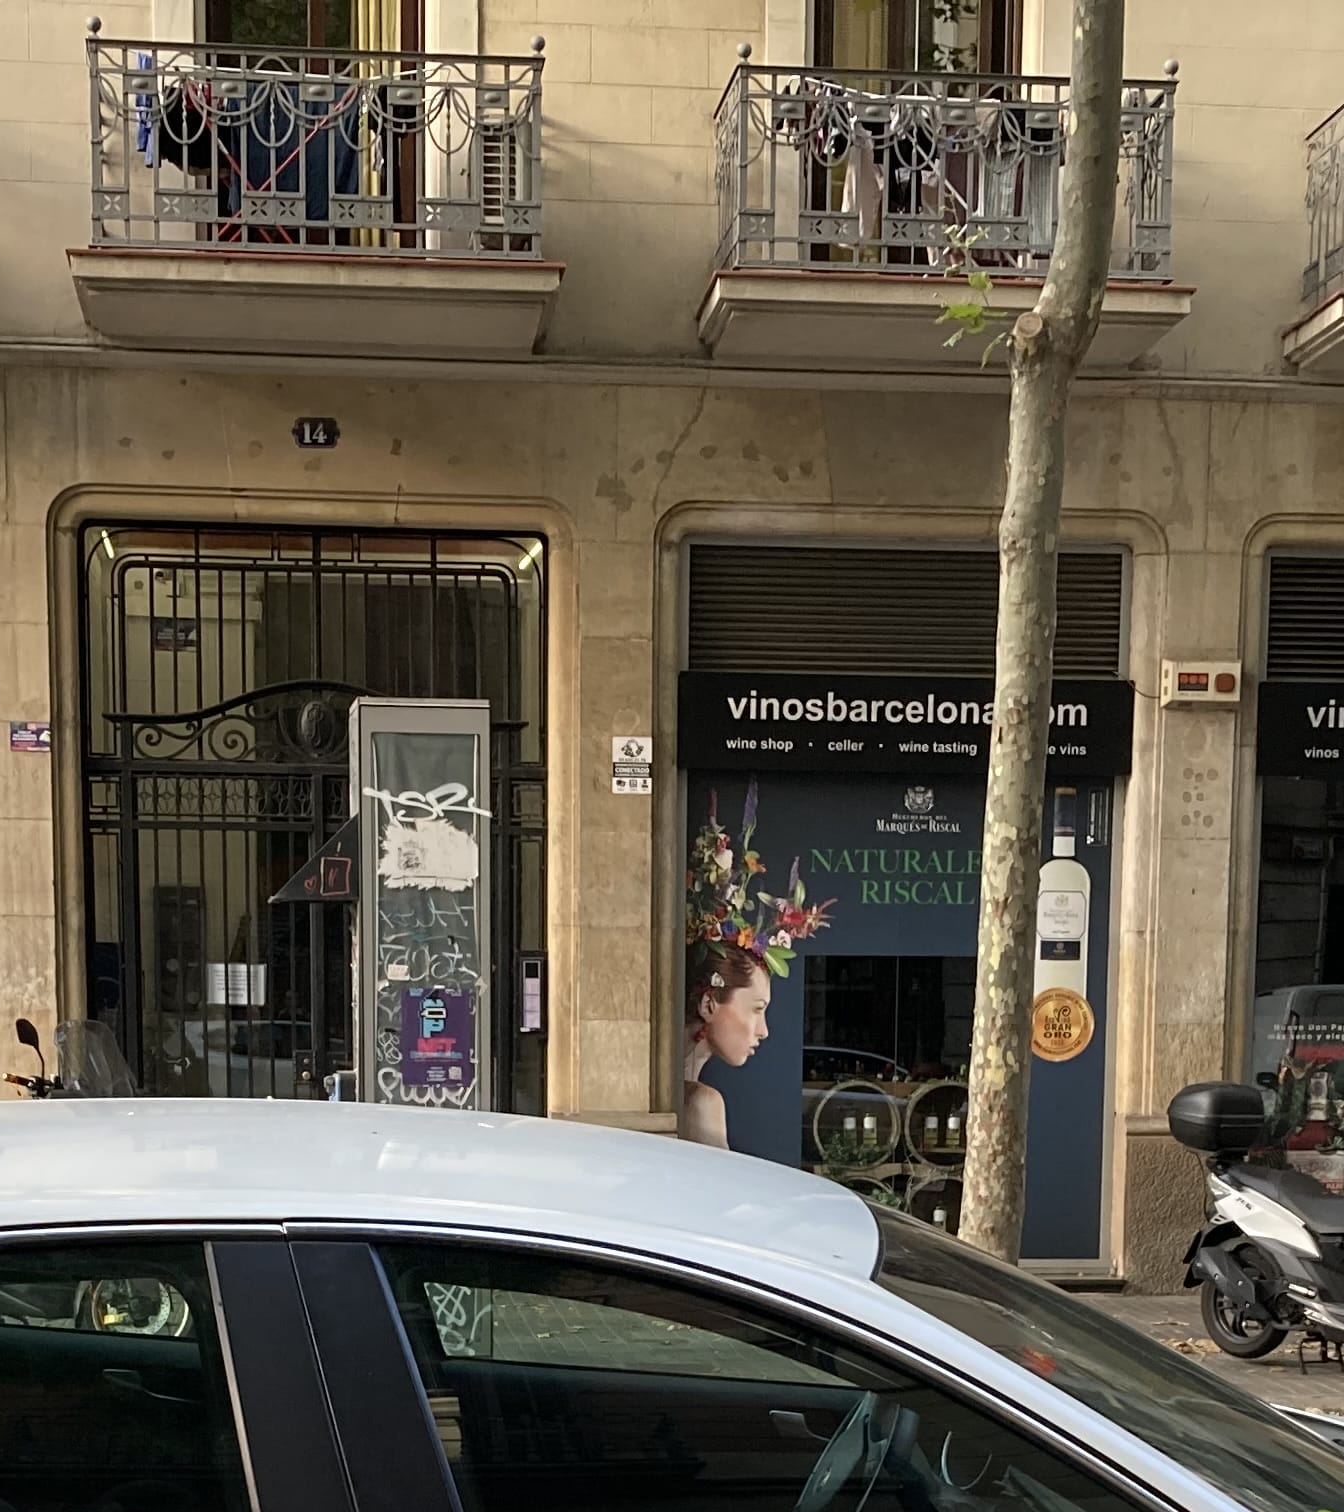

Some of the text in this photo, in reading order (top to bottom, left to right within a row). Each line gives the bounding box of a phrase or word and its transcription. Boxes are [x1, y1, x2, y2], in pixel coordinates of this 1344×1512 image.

[303, 422, 327, 443] 14
[727, 690, 1088, 727] vinosbarcelonaom
[726, 738, 757, 750] wine
[760, 739, 794, 752] shop
[828, 740, 865, 752] celler
[899, 741, 929, 753] wine
[932, 741, 978, 756] tasting
[1059, 743, 1087, 756] vins
[1304, 746, 1340, 759] vinos
[929, 819, 961, 833] RISCAL
[861, 880, 976, 905] RISCAL
[1308, 1024, 1327, 1032] Don
